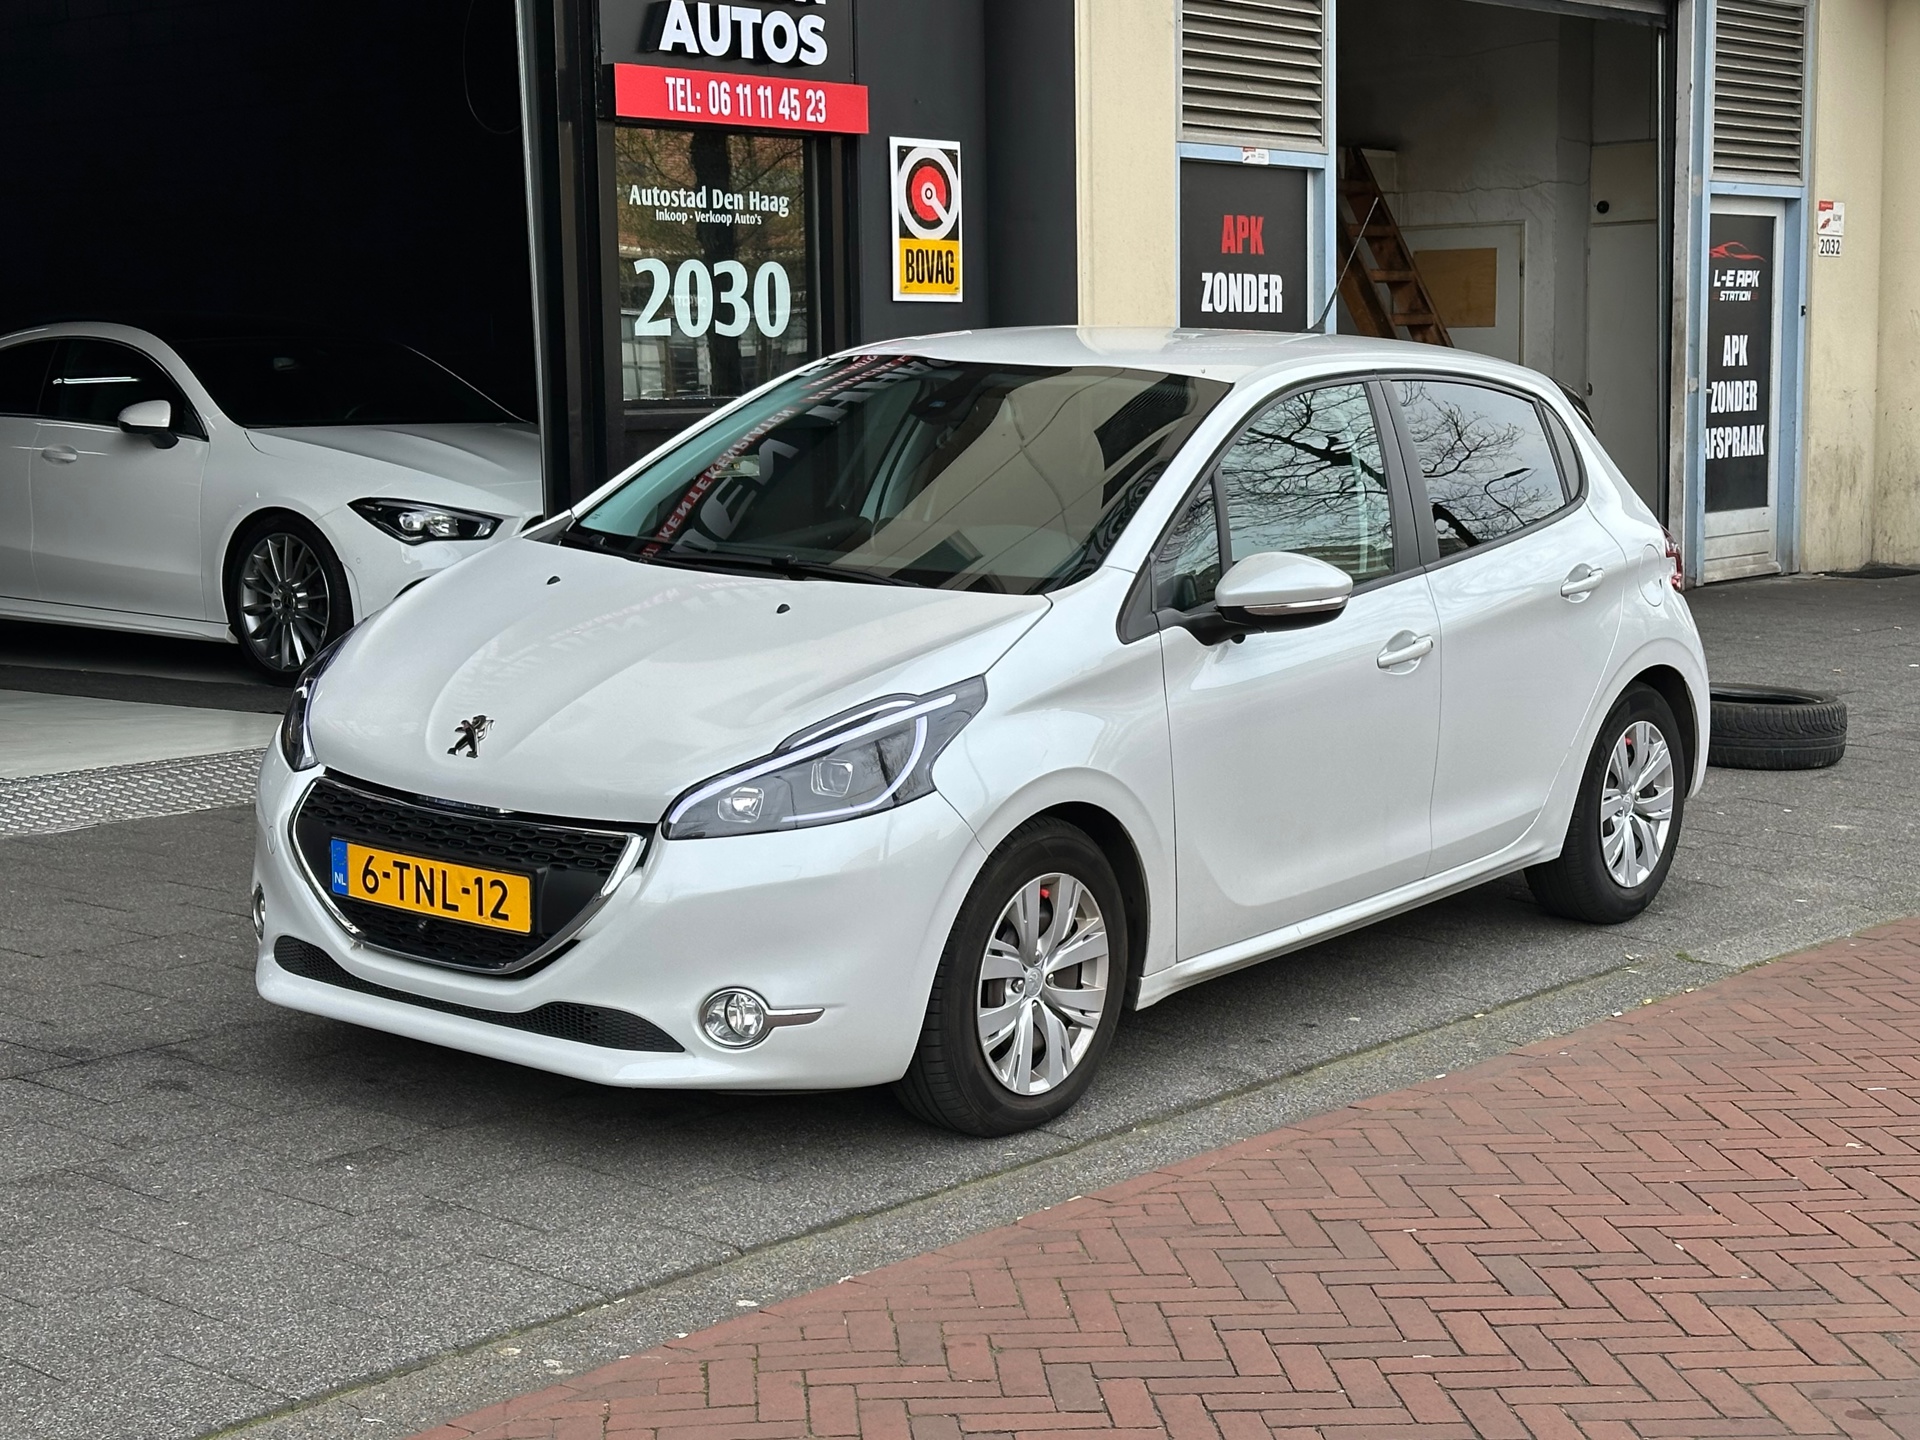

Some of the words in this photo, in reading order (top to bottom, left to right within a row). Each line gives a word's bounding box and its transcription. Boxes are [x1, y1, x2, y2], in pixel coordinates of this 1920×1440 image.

[659, 0, 828, 66] AUTOS
[665, 76, 702, 113] TEL:
[708, 80, 731, 116] 06
[736, 83, 752, 117] 11
[757, 85, 773, 119] 11
[778, 87, 800, 121] 45
[805, 89, 827, 123] 23
[629, 184, 707, 209] Autostad
[712, 189, 744, 210] Den
[749, 191, 790, 218] Haag
[655, 209, 688, 225] Inkoop
[695, 210, 733, 227] Verkoop
[734, 212, 762, 225] Auto's
[1221, 214, 1264, 255] APK
[1820, 238, 1840, 255] 2032
[905, 248, 955, 285] BOVAG
[1713, 269, 1736, 288] L-E
[1735, 269, 1760, 288] APK
[633, 258, 791, 338] 2030
[1201, 272, 1283, 313] ZONDER
[1719, 290, 1752, 302] STATION
[1722, 334, 1748, 367] APK
[1710, 380, 1758, 413] ZONDER
[334, 872, 347, 886] NL
[361, 855, 510, 921] 6-TNL-12
